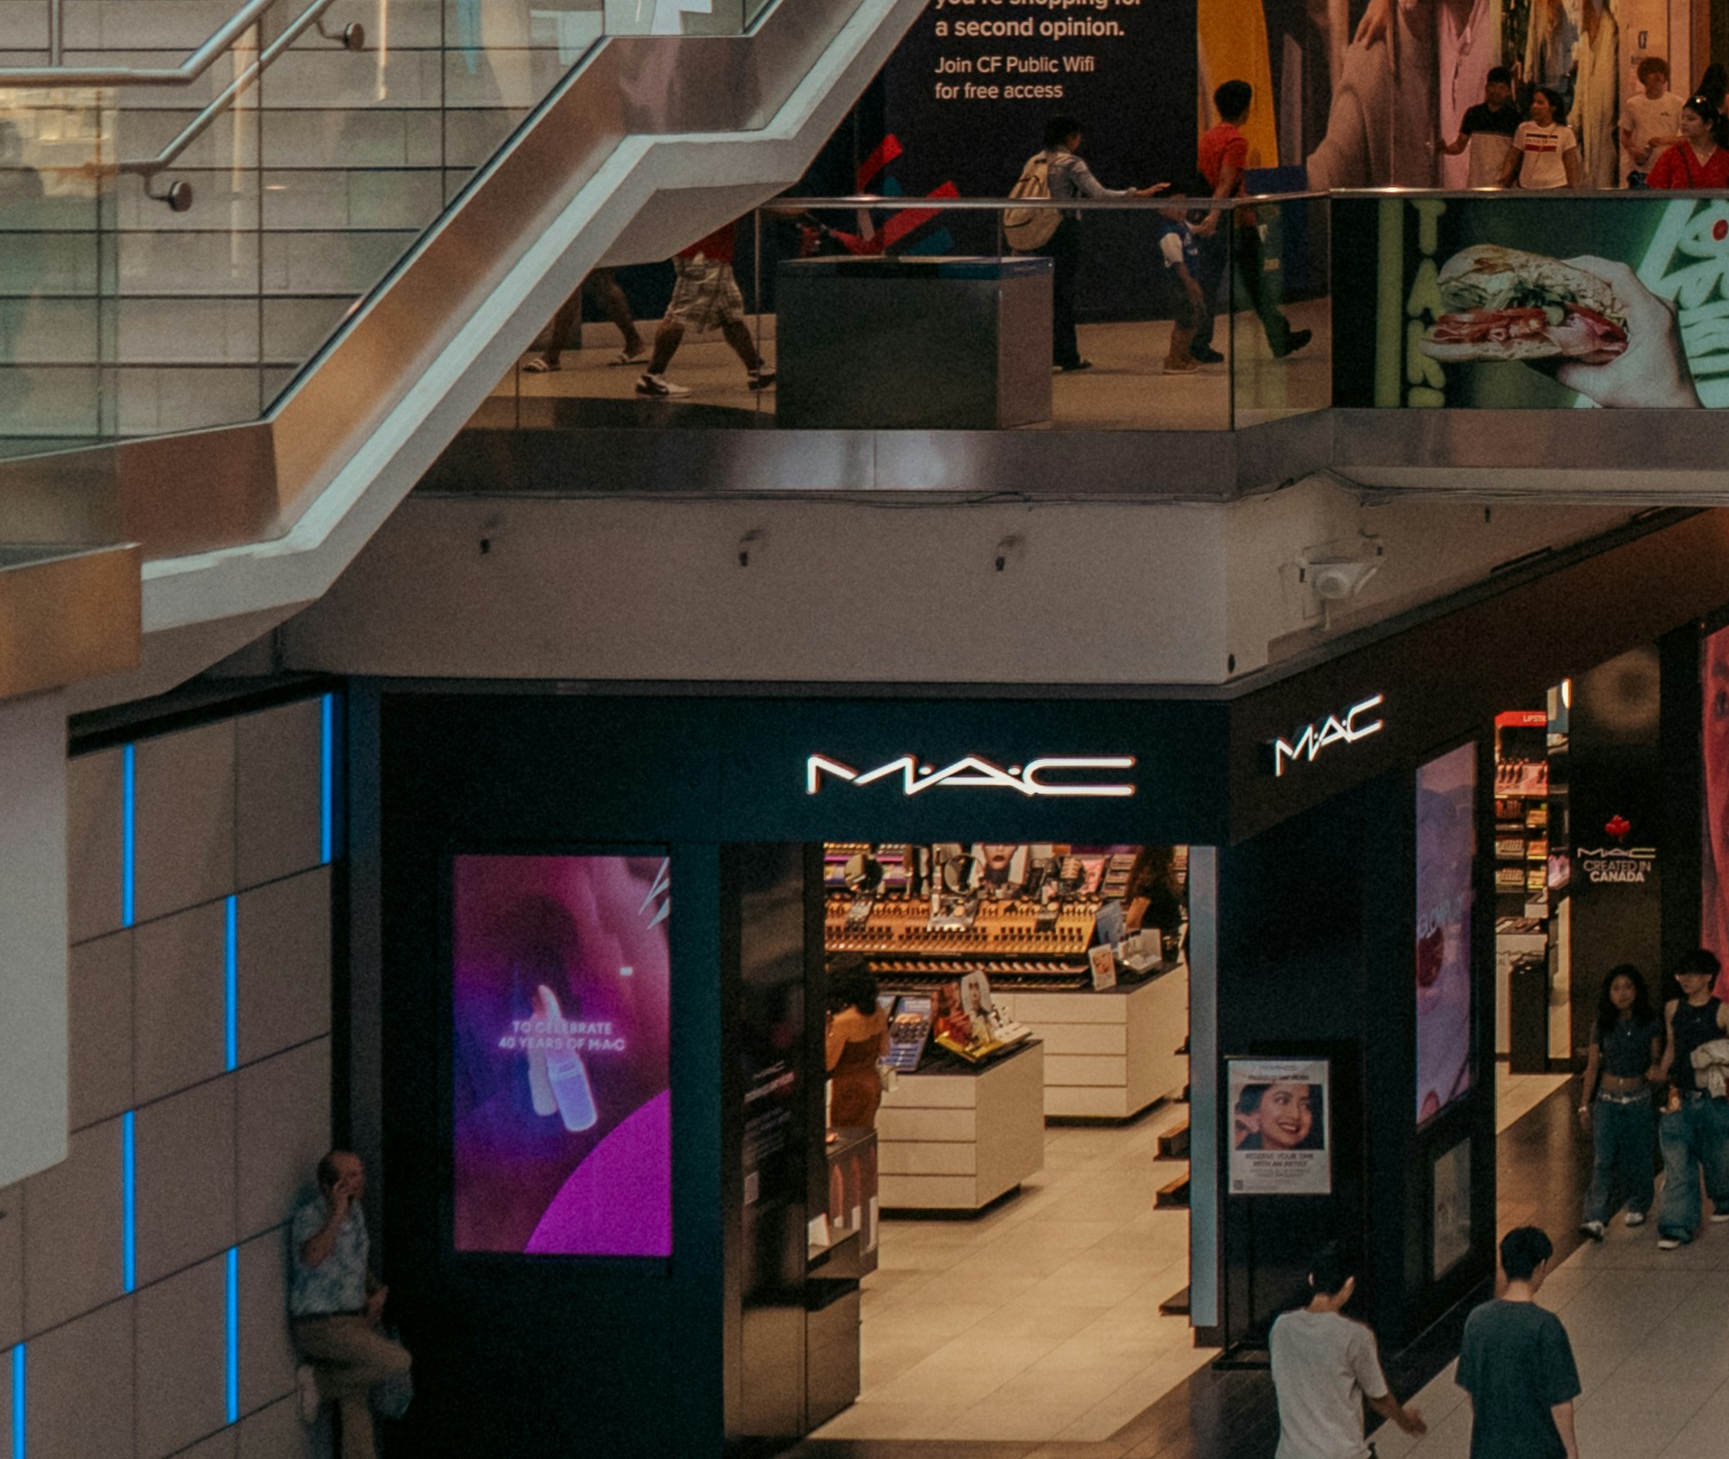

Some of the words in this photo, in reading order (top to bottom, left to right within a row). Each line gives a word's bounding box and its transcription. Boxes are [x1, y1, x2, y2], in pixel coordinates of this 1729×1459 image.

[934, 20, 949, 37] a
[954, 17, 1034, 37] second
[1039, 17, 1125, 41] opinion.
[935, 56, 972, 74] Join
[976, 56, 1002, 74] CF
[1006, 56, 1059, 74] Public
[1062, 55, 1095, 73] Wifi
[935, 82, 960, 100] for
[964, 82, 999, 100] free
[1003, 84, 1063, 100] access
[1583, 860, 1638, 872] CREATED
[1639, 861, 1652, 872] IN
[1590, 872, 1646, 883] CANADA
[512, 1021, 532, 1034] TO
[535, 1021, 613, 1035] CELEBRATE
[498, 1037, 516, 1049] 40
[519, 1037, 563, 1050] YEARS
[566, 1038, 586, 1050] OF
